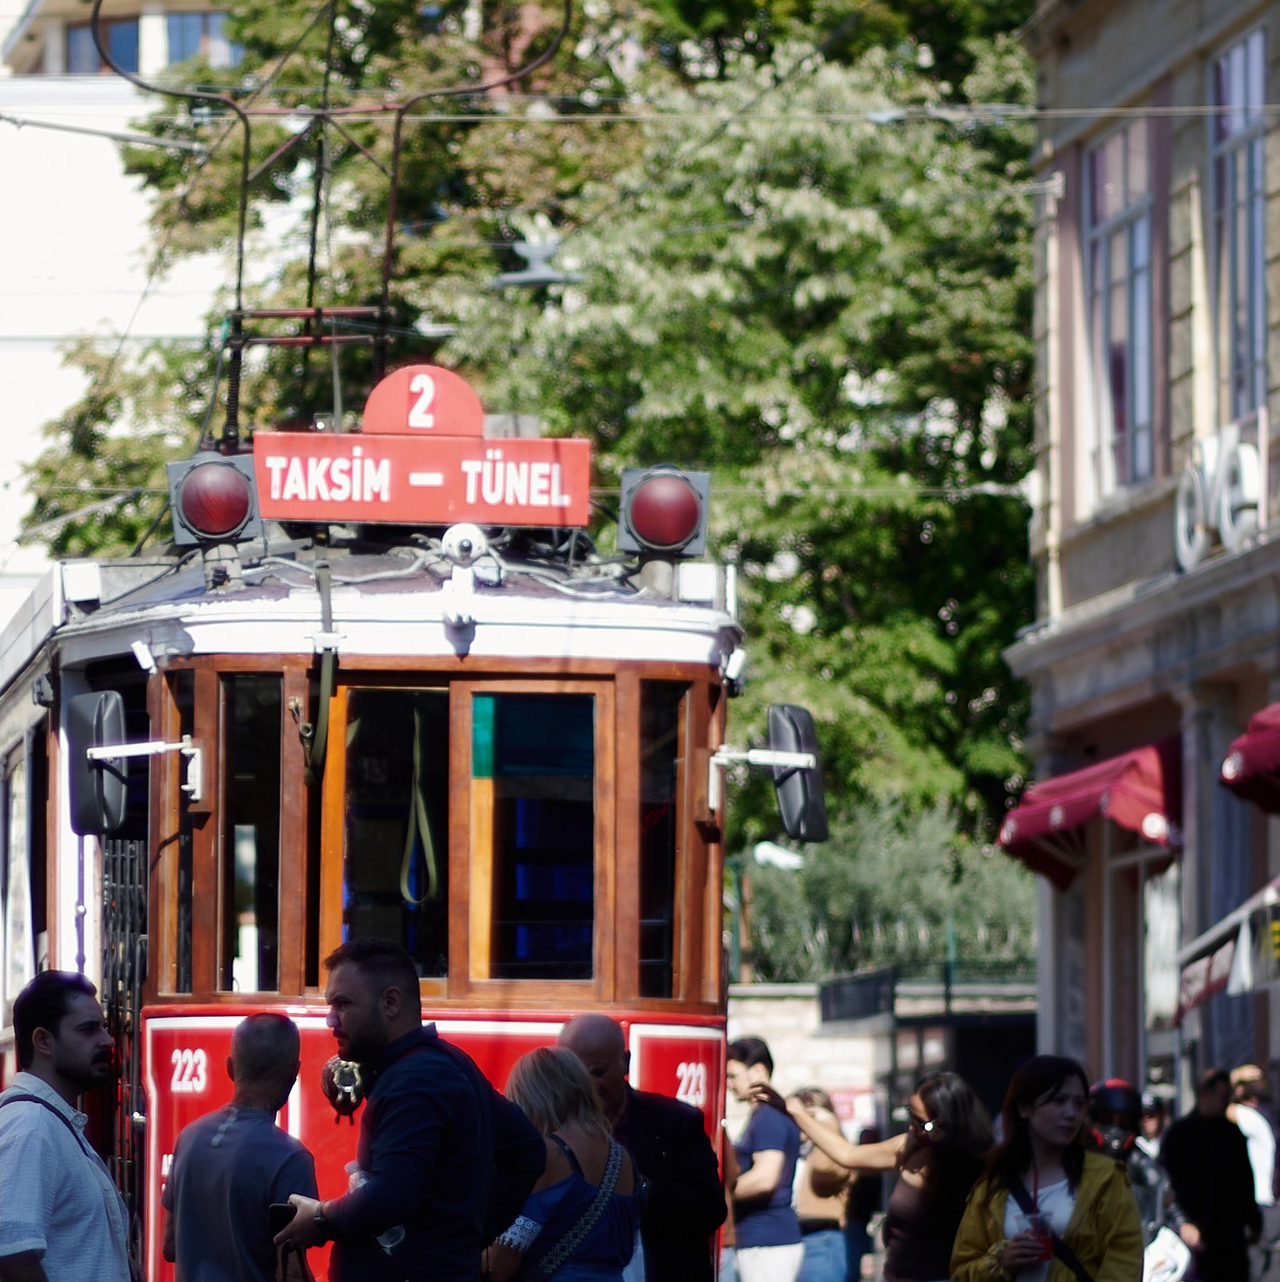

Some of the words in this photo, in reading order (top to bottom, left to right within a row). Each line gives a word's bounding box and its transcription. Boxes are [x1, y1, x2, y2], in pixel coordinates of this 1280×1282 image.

[408, 373, 435, 429] 2
[265, 445, 391, 502] TAKSİM
[461, 449, 570, 506] TÜNEL
[170, 1048, 207, 1093] 223
[675, 1061, 708, 1108] 223
